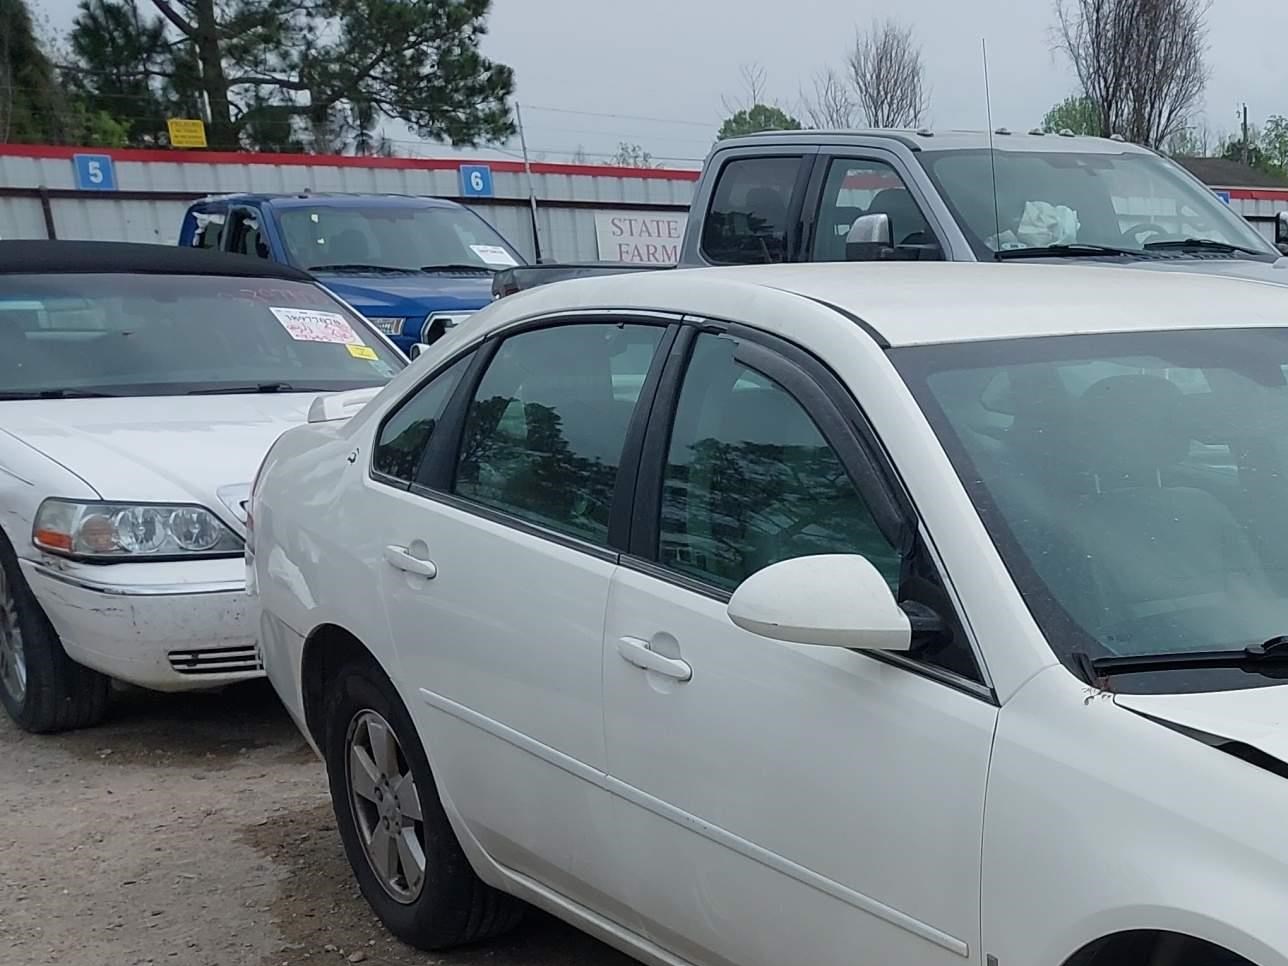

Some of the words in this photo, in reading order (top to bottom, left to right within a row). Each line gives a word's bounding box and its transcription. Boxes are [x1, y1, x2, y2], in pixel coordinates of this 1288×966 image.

[88, 161, 103, 183] 5
[470, 171, 484, 191] 6
[611, 217, 680, 238] STATE
[618, 243, 678, 263] FARM
